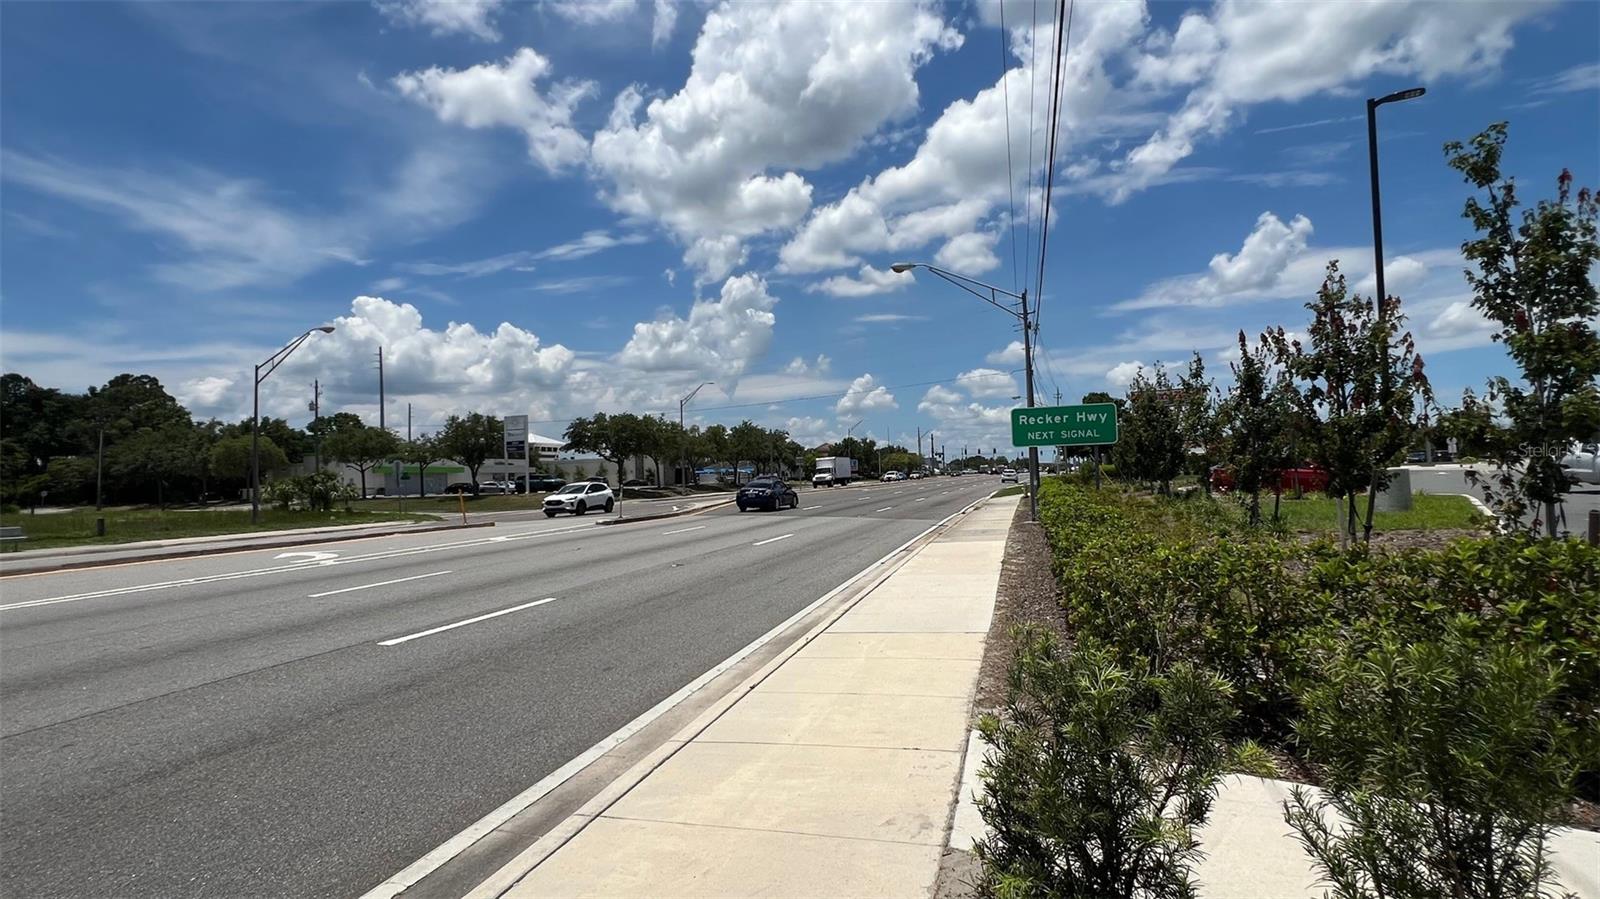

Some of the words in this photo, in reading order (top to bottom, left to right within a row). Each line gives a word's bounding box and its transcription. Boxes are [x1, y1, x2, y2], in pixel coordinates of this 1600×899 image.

[1019, 413, 1069, 425] Recker
[1076, 411, 1107, 424] Hwy
[1027, 431, 1055, 440] NEXT
[1060, 429, 1100, 439] SIGNAL
